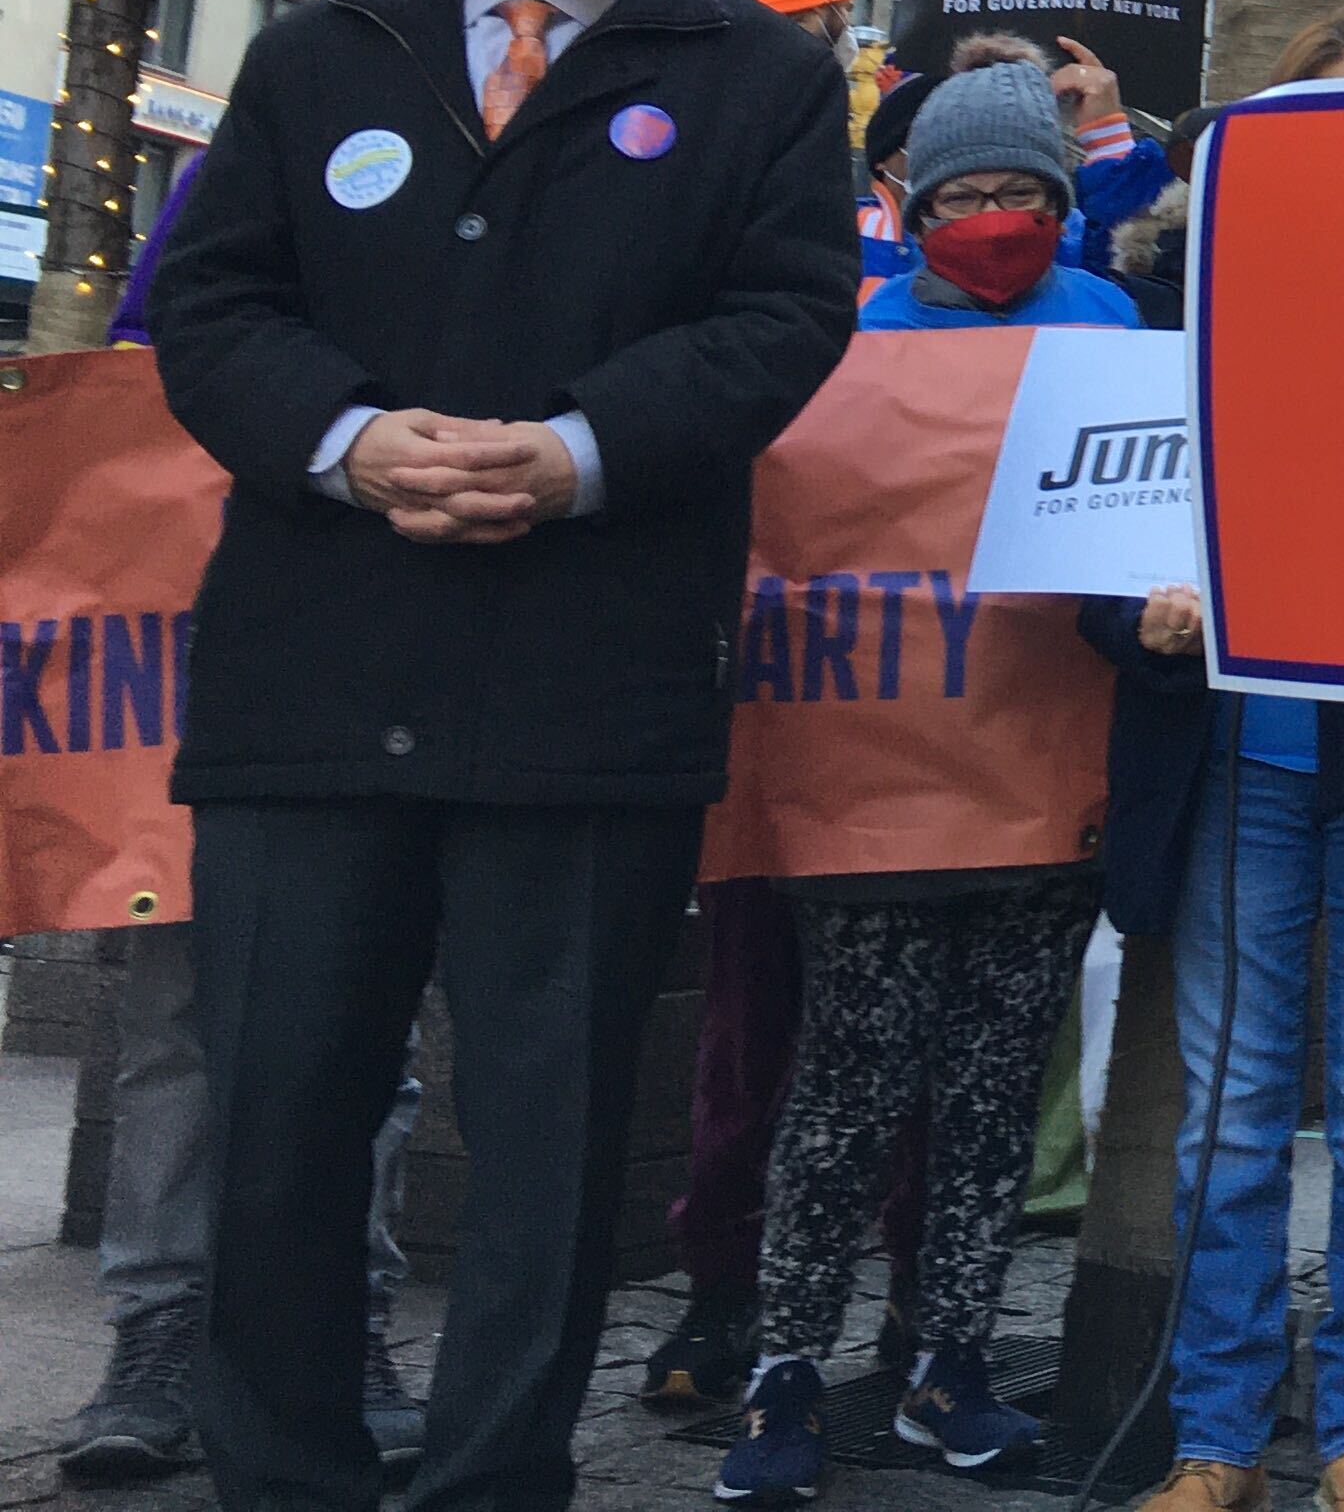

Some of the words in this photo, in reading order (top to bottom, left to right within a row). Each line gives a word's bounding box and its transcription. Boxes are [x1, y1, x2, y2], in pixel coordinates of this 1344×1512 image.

[1113, 0, 1143, 15] NEW
[1146, 3, 1181, 21] YORK
[1033, 498, 1079, 517] FOR
[743, 569, 980, 702] ARTY
